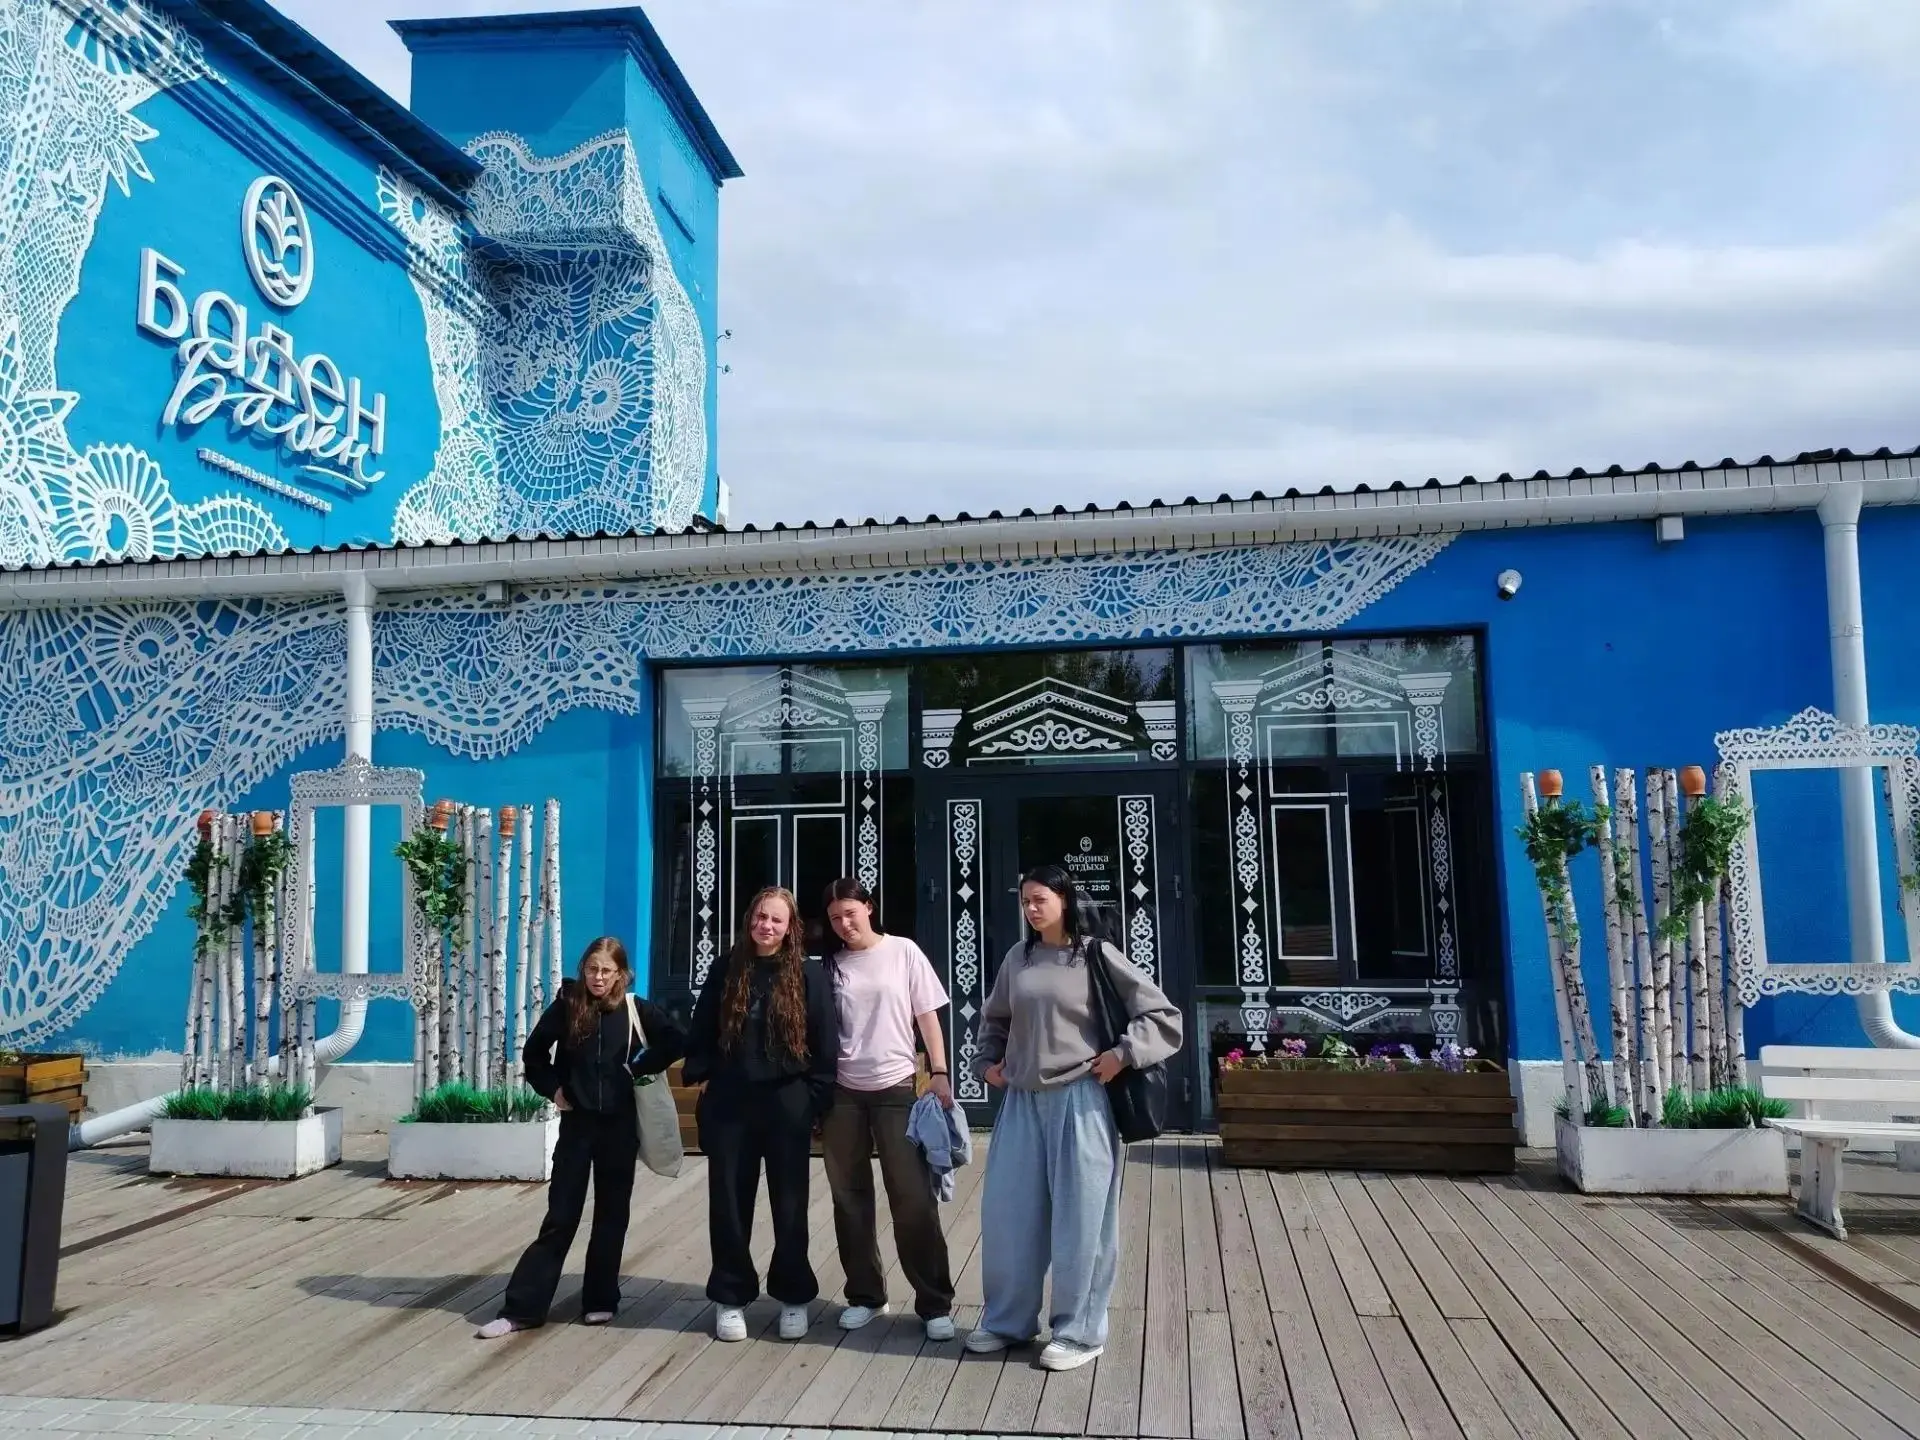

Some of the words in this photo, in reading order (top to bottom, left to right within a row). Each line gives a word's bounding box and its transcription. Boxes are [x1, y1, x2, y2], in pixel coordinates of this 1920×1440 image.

[197, 447, 283, 493] ТЕРМАЛЬНЫЕ
[284, 483, 332, 512] КУРОРТЫ
[1064, 853, 1109, 864] Фабрика
[1068, 863, 1105, 872] отдыха
